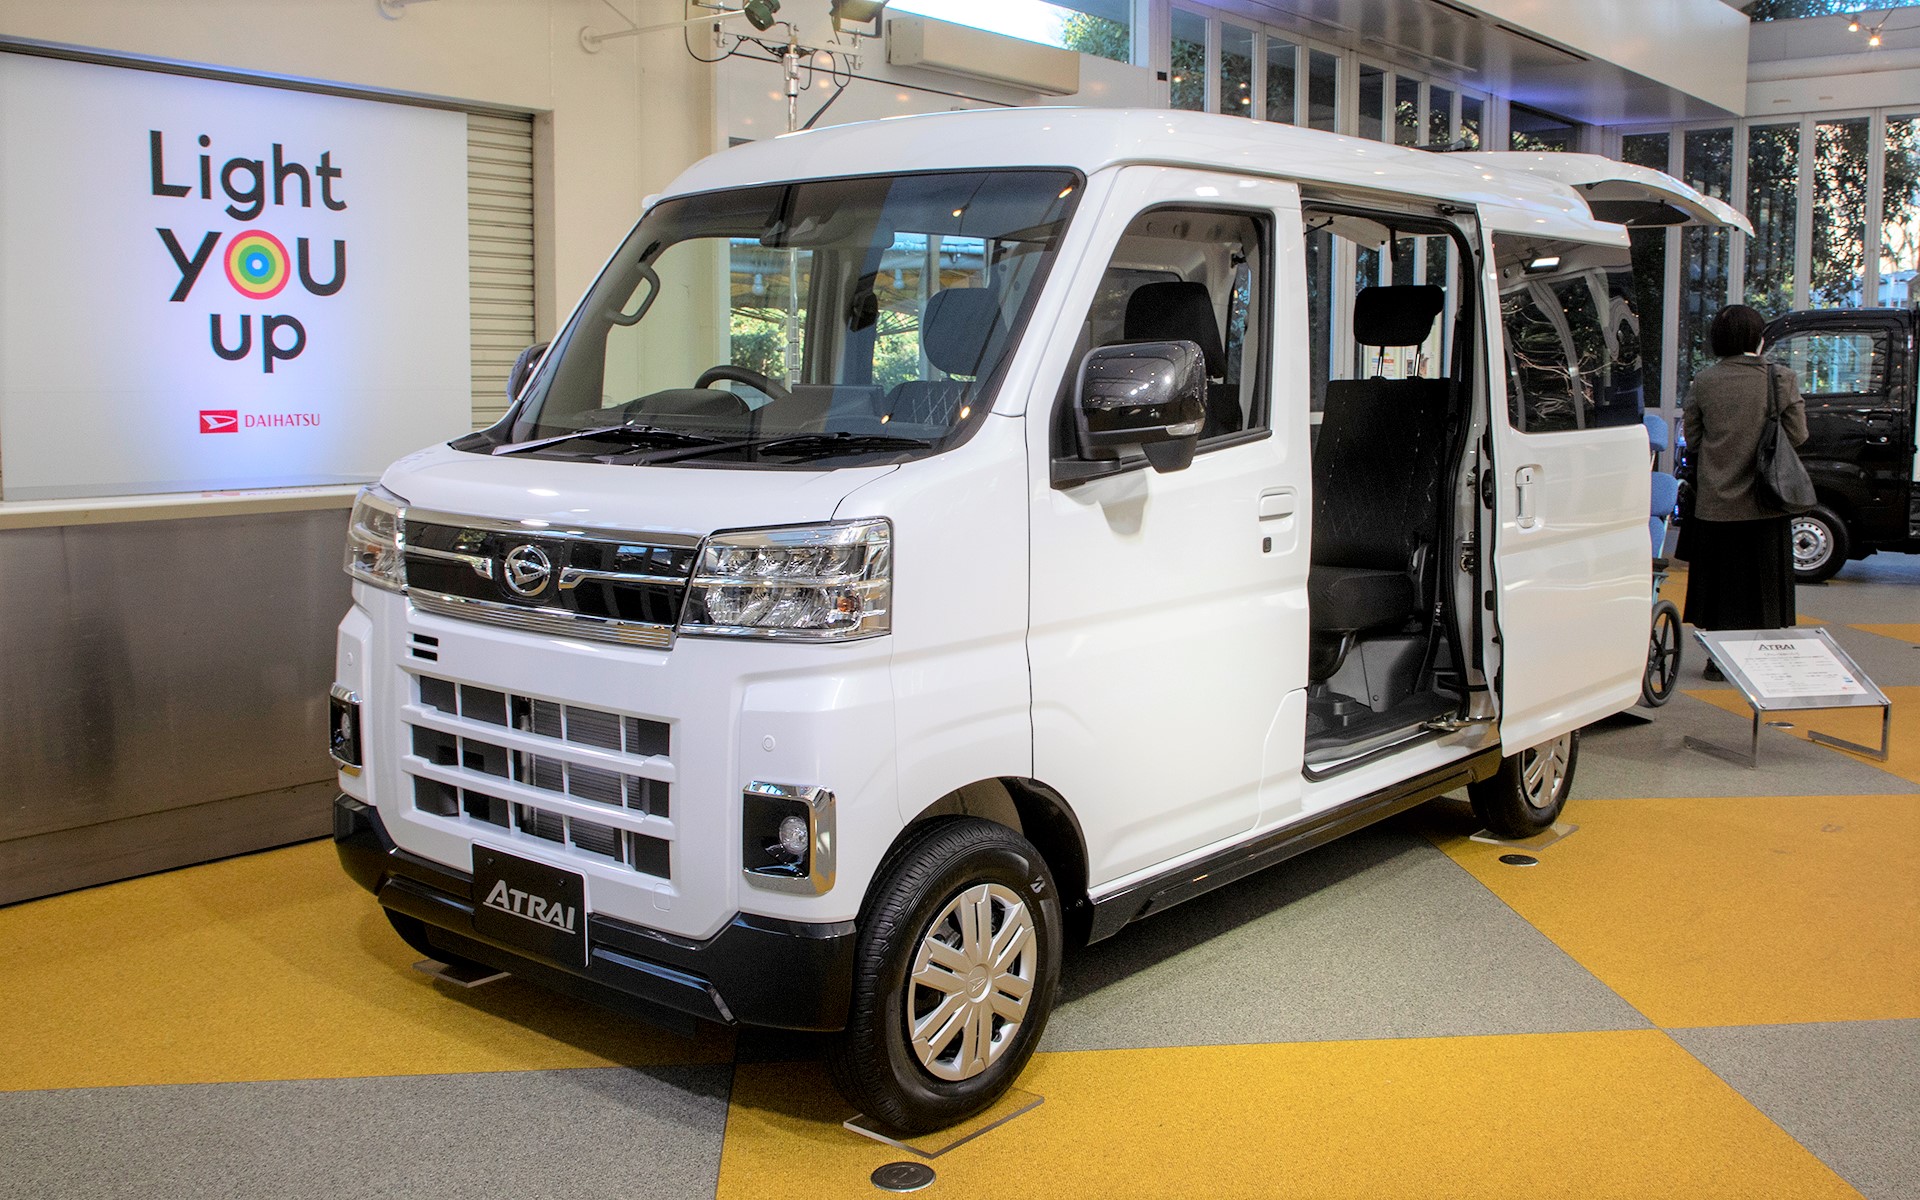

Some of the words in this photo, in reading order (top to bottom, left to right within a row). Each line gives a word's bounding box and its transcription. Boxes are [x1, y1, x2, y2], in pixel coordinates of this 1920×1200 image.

[149, 129, 347, 222] Light
[209, 313, 307, 374] up
[244, 413, 321, 428] DAIHATSU
[1758, 643, 1796, 651] ATRAI
[485, 879, 576, 931] ATRAI
